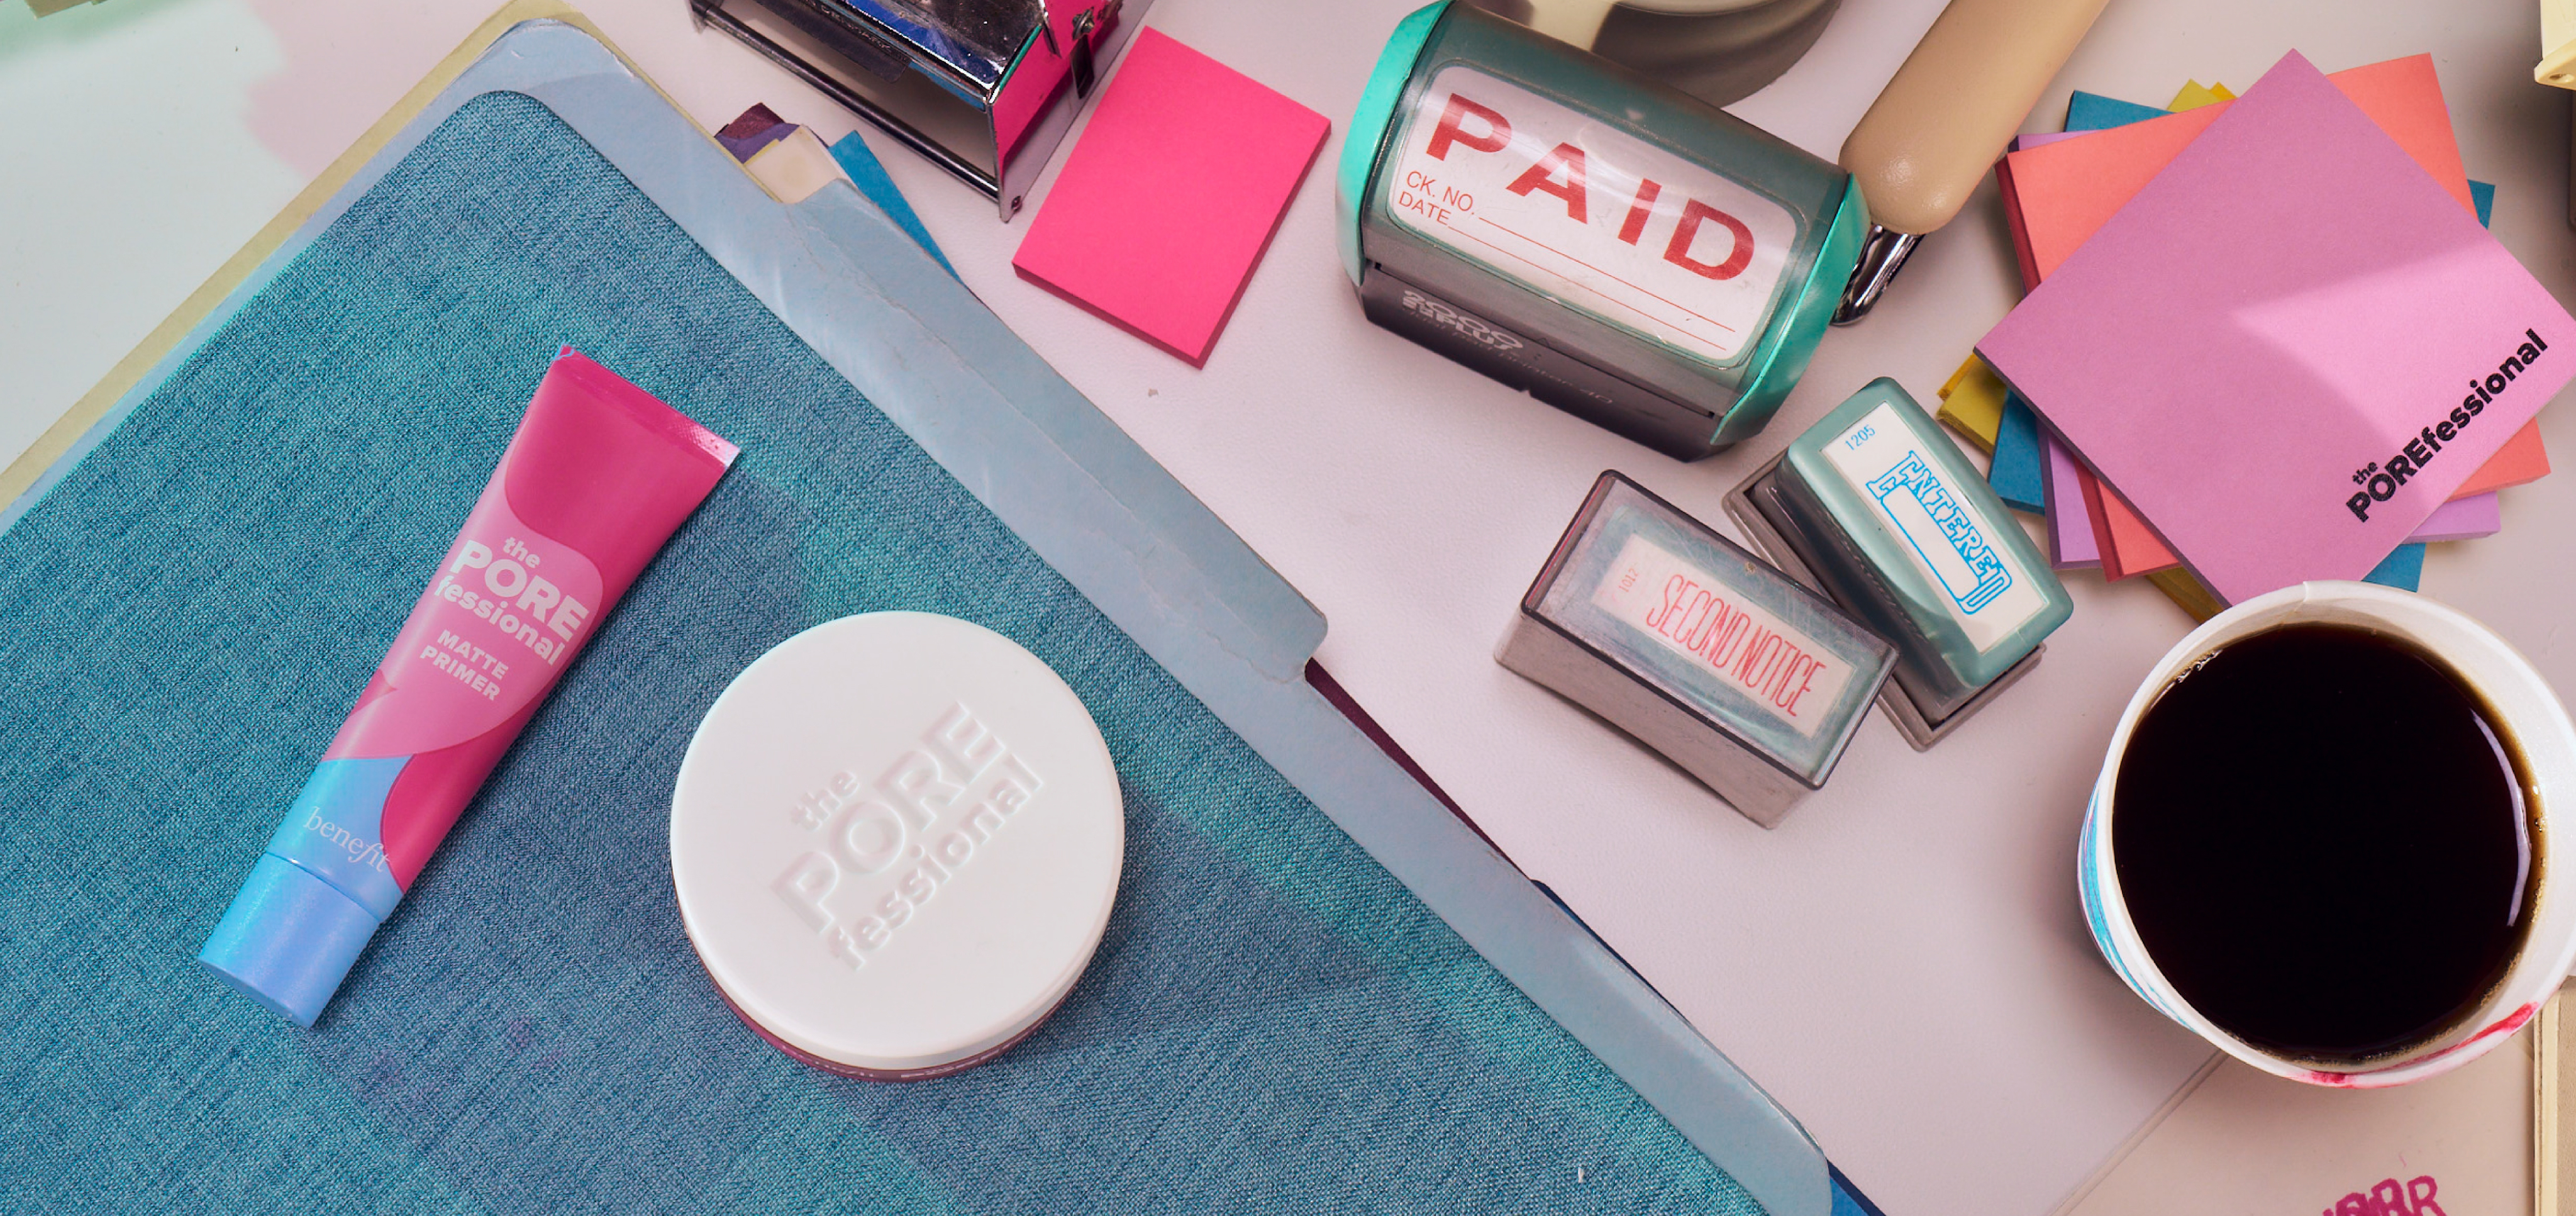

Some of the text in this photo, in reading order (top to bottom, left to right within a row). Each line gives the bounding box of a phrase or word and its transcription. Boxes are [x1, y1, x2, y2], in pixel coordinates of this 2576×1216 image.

[1399, 191, 1452, 226] DATE
[1407, 170, 1474, 216] CK. NO.
[1426, 92, 1755, 281] PAID
[1404, 291, 1524, 349] 2000
[1845, 424, 1876, 450] 1205
[2346, 328, 2548, 523] POREfessional
[2352, 461, 2379, 485] the
[502, 537, 541, 568] the
[1865, 450, 2012, 615] ENTERED
[449, 539, 589, 642] PORE
[1618, 567, 1638, 593] 1012
[434, 575, 565, 666] fessional
[1646, 574, 1752, 669] SECOND
[1731, 624, 1827, 717] NOTICE
[419, 645, 501, 701] PRIMER
[437, 629, 509, 681] MATTE
[769, 700, 1006, 934] PORE
[790, 770, 860, 832] the
[303, 806, 390, 873] benefit
[827, 753, 1044, 972] fessional
